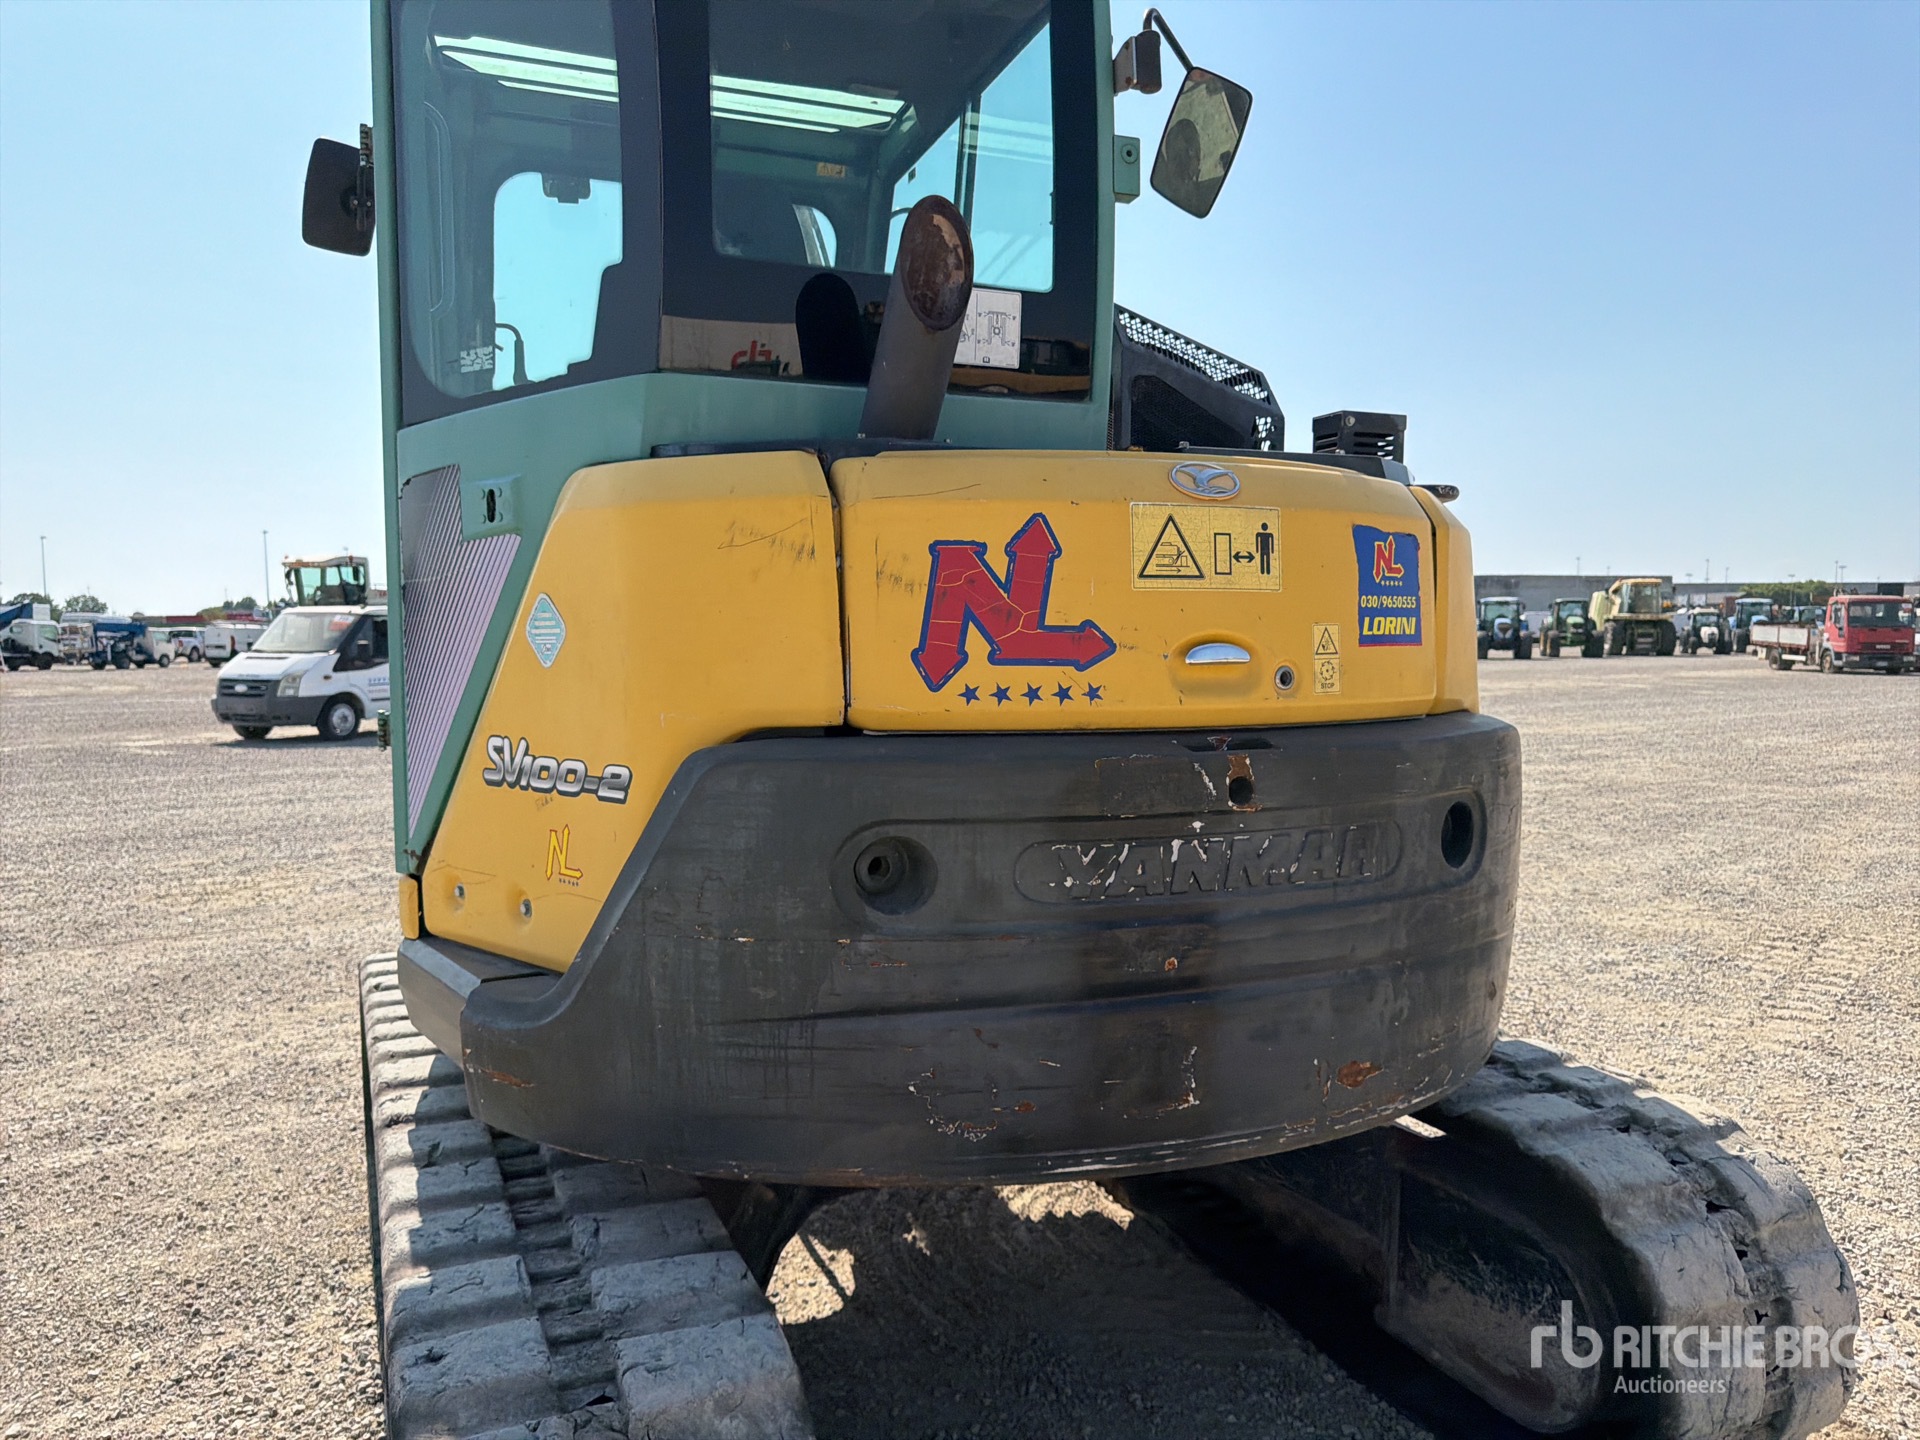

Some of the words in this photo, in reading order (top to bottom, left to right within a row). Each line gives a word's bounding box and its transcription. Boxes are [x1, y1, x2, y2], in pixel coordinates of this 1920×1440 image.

[1361, 595, 1416, 608] 030/9650555
[1363, 616, 1416, 635] LORINI
[1320, 682, 1335, 690] STOP
[482, 734, 633, 805] SV100-2
[1049, 825, 1374, 900] YANMAR
